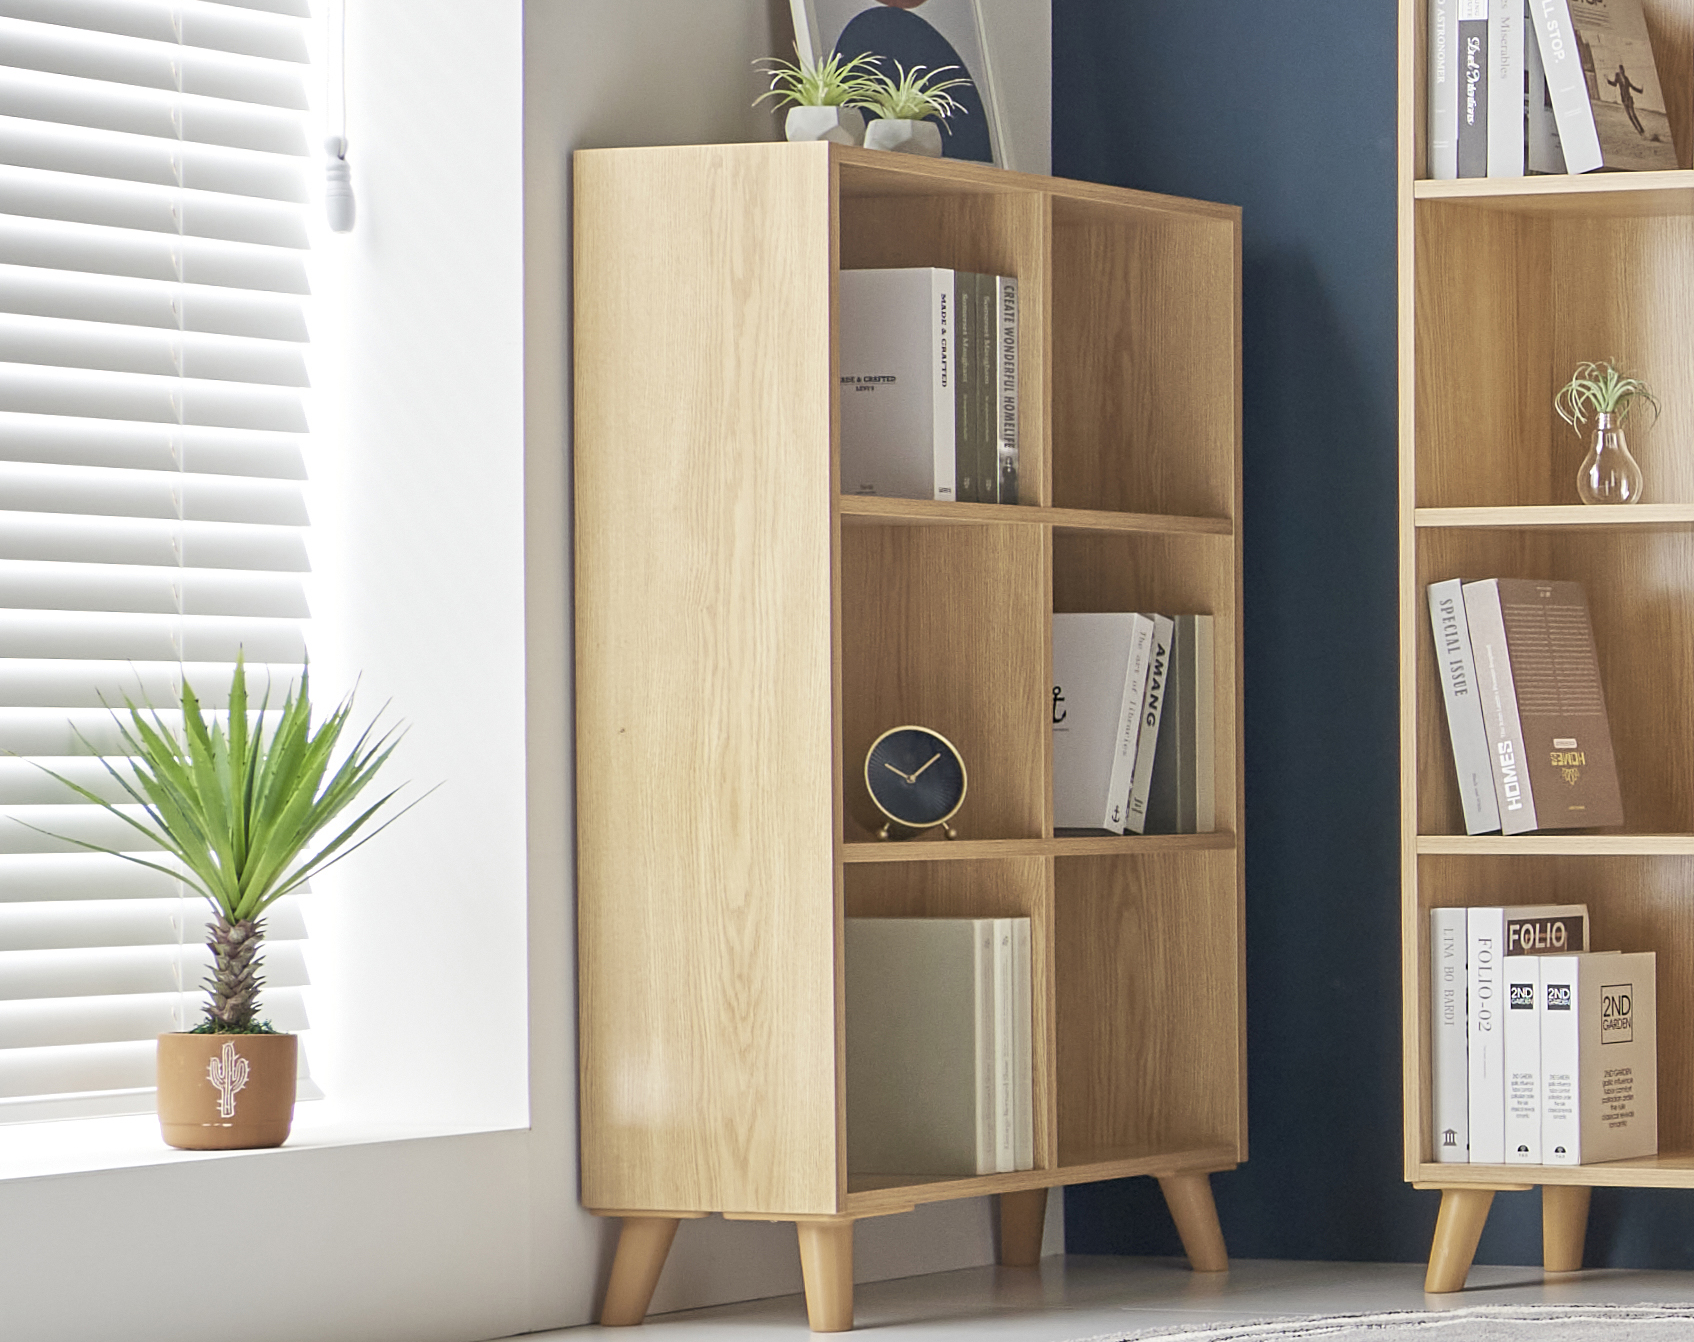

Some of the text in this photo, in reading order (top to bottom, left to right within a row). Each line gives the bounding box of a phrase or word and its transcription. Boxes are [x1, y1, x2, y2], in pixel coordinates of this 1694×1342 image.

[1436, 9, 1446, 84] ASTRONOMER
[1500, 16, 1511, 80] Miserables
[1547, 19, 1566, 63] STOP.
[1003, 285, 1015, 448] CREATE WONDERFUL HOMELIFE
[1440, 598, 1468, 697] SPECIAL ISSUE
[1146, 643, 1165, 728] AMANG
[1498, 740, 1522, 811] HOMES
[1508, 921, 1566, 951] FOLIO
[1443, 928, 1455, 1026] LINA BO BARDI
[1478, 938, 1493, 1032] FOLIO-02
[1511, 987, 1533, 999] 2ND
[1548, 988, 1570, 999] 2ND
[1603, 995, 1631, 1017] 2ND
[1602, 1017, 1631, 1031] GARDEN
